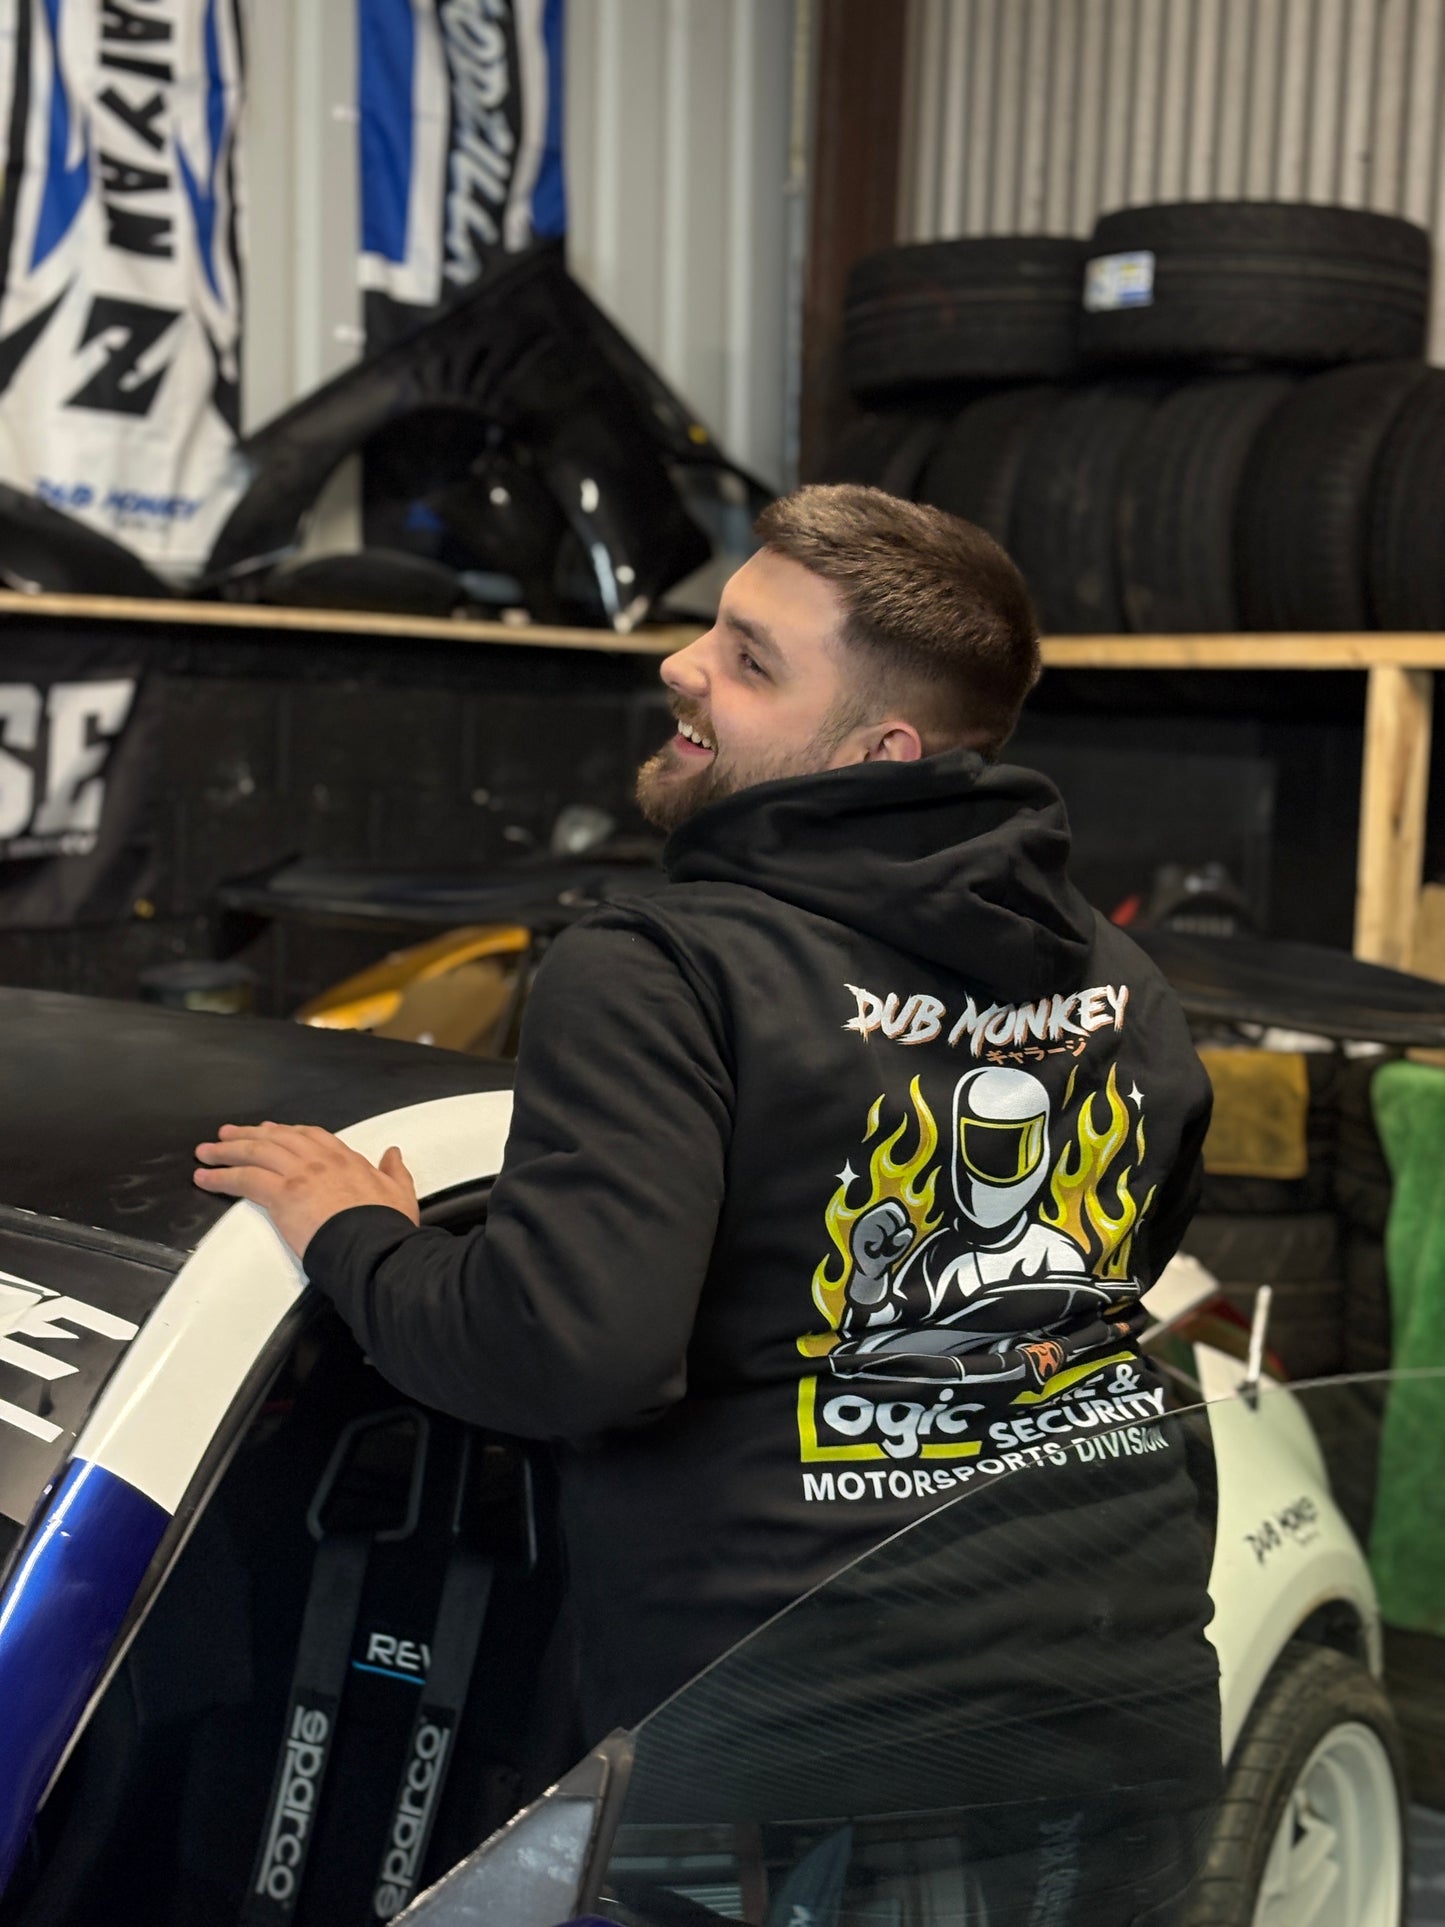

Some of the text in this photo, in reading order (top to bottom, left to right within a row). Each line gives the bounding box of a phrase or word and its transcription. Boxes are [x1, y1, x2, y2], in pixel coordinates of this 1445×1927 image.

[99, 0, 173, 259] AIYAN
[441, 0, 510, 284] ODZILLA
[841, 983, 1129, 1058] DUB MONKEY
[1107, 1364, 1141, 1393] &
[988, 1387, 1165, 1449] SECURITY
[802, 1440, 1068, 1501] MOTORSPORTS
